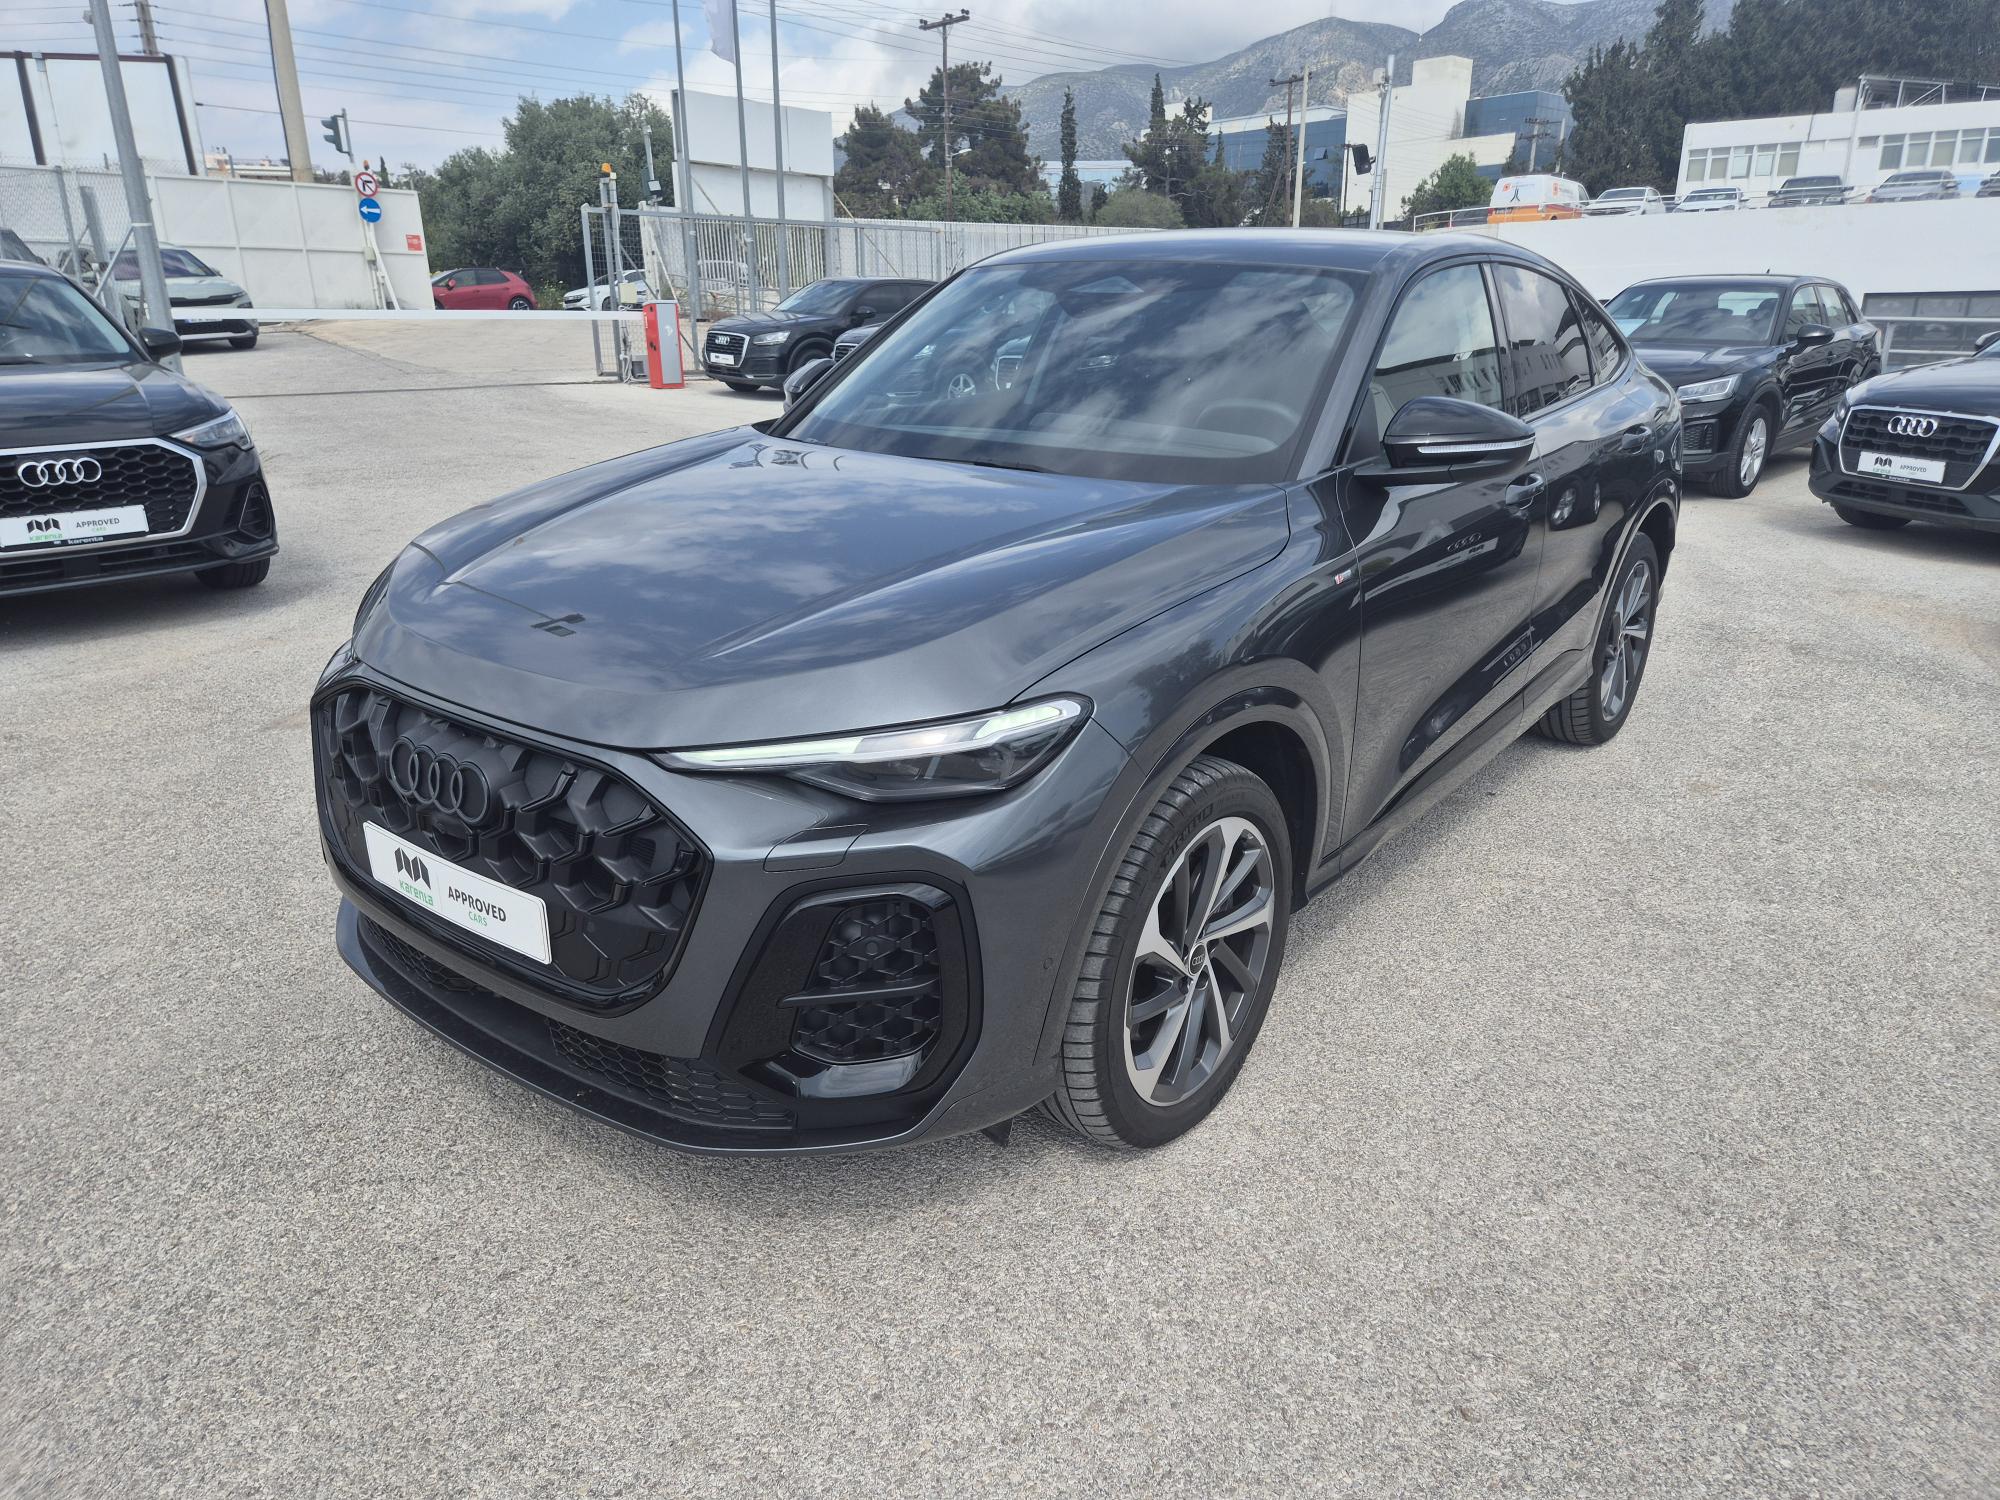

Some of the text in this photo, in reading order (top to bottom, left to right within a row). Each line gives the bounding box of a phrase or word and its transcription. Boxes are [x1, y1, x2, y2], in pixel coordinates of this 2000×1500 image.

[1900, 464, 1927, 473] APPROVED
[76, 517, 120, 528] APPROVED
[67, 536, 104, 545] karenta
[399, 880, 434, 906] karenta
[448, 885, 507, 922] APPROVED
[468, 911, 488, 927] CARS
